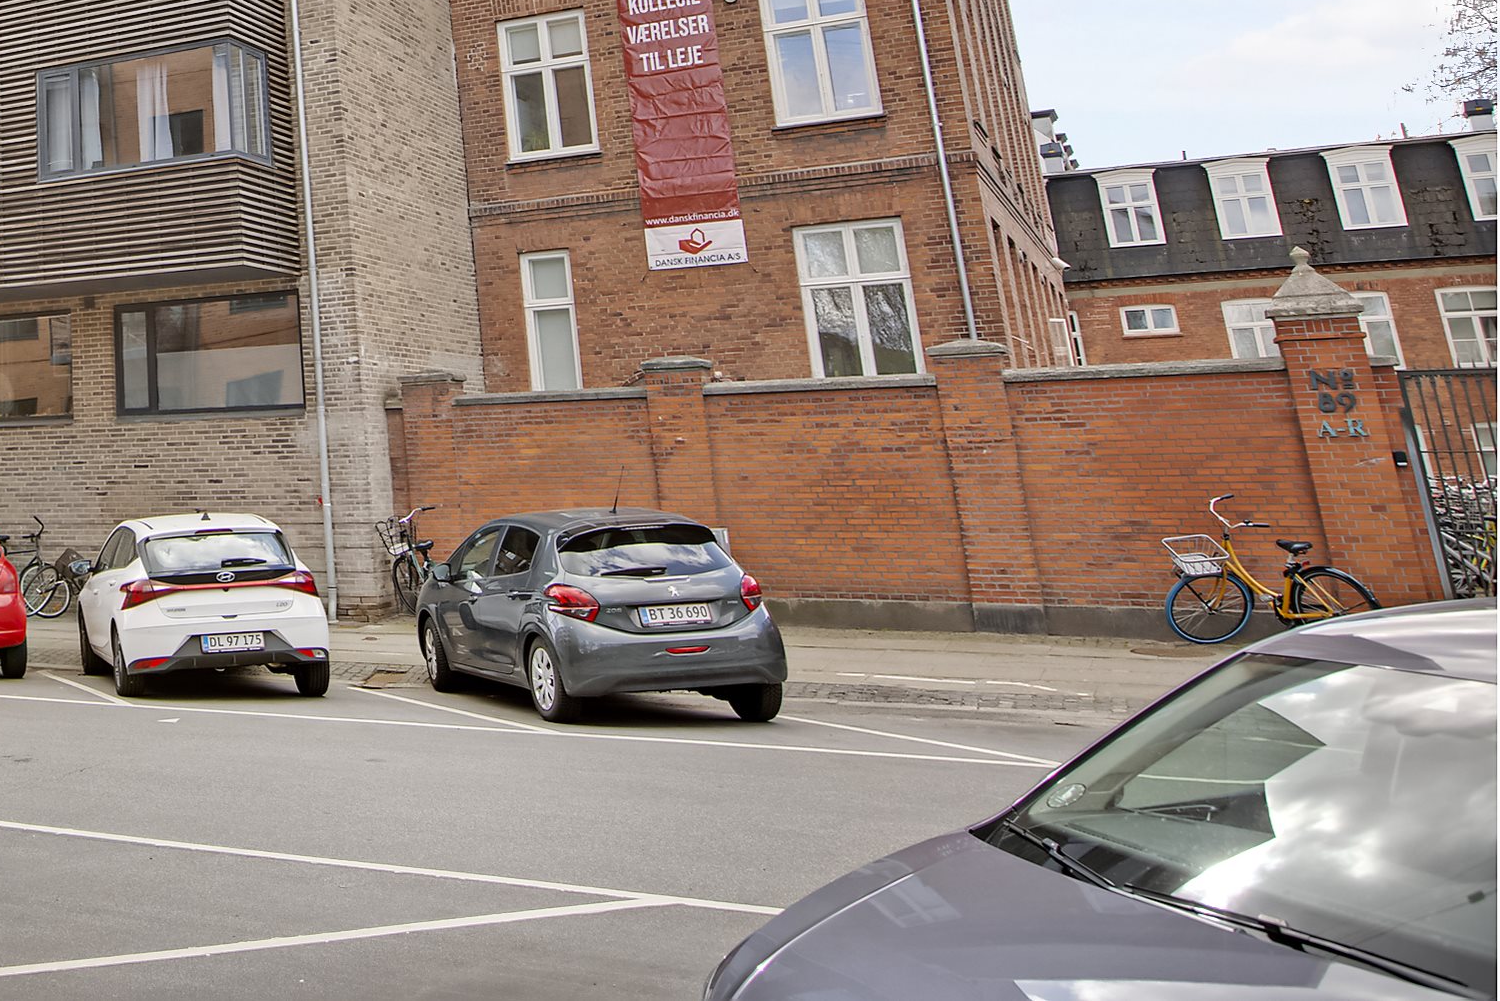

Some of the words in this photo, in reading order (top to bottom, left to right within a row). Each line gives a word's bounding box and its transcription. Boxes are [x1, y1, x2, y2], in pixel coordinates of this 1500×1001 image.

[626, 14, 709, 45] VÆRELSER
[639, 51, 665, 72] TIL
[666, 45, 704, 68] LEJE
[644, 208, 740, 225] www.danskfinancia.dk
[655, 257, 683, 267] DANSK
[684, 253, 724, 265] FINANCIA
[726, 252, 741, 261] A/S
[1318, 392, 1357, 414] 89
[1318, 419, 1369, 438] A-R
[649, 607, 665, 621] BT
[668, 606, 684, 619] 36
[685, 605, 707, 618] 690
[209, 636, 224, 647] DL
[226, 635, 239, 646] 97
[243, 634, 262, 645] 175
